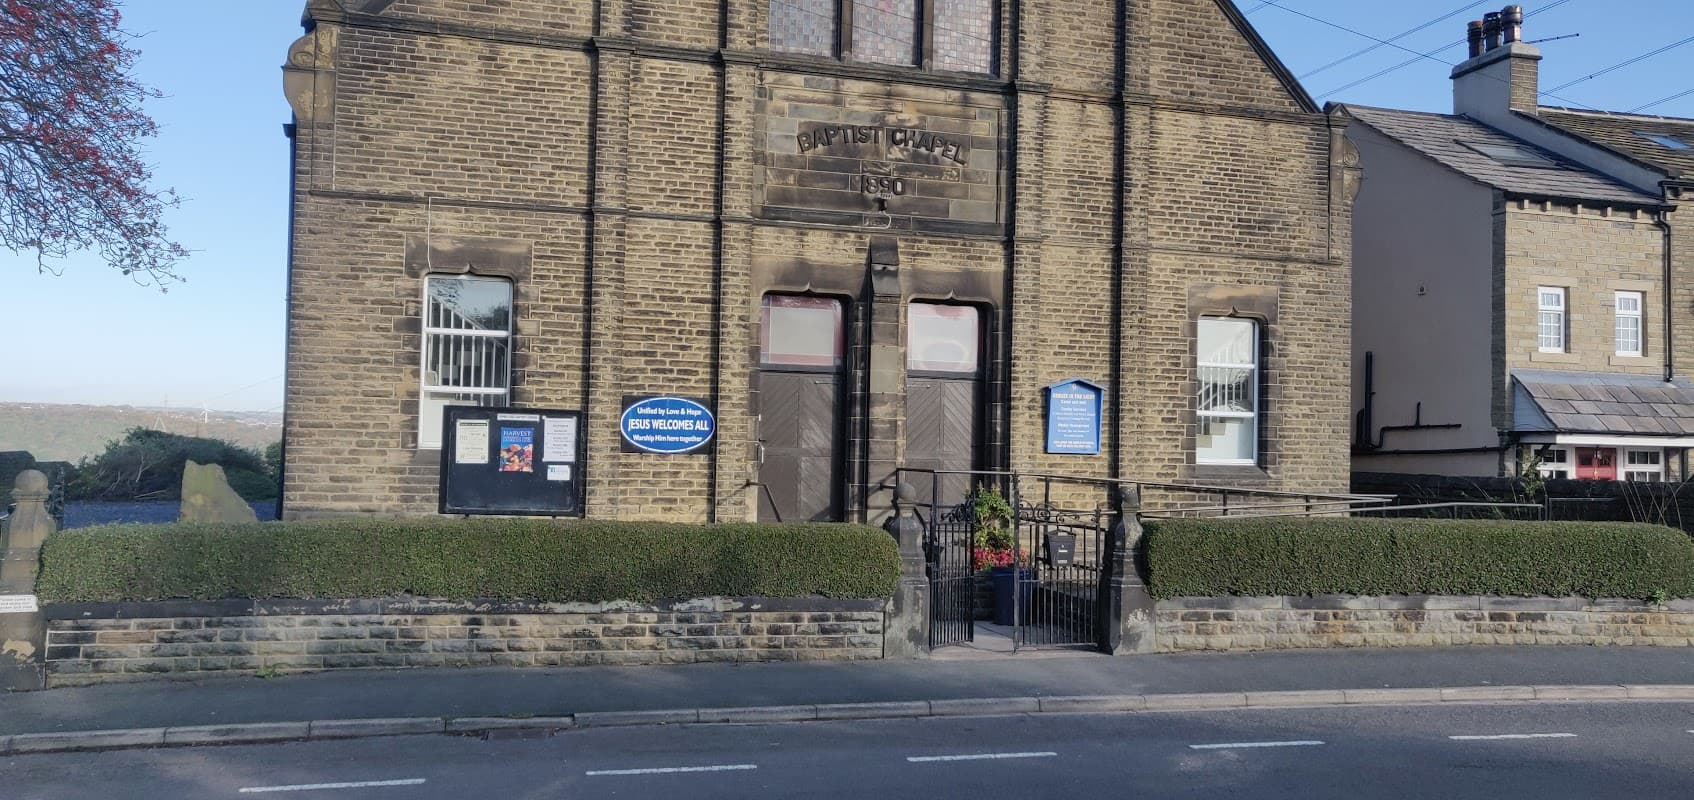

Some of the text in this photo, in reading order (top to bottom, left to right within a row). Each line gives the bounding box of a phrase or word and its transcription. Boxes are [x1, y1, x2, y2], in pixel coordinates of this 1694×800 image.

[797, 126, 967, 166] BAPTIST CHAPEL
[861, 175, 905, 195] 1890
[658, 408, 665, 416] by
[686, 408, 702, 417] Hope
[628, 418, 709, 432] JESUS WELCOMES ALL
[633, 434, 655, 443] Worship
[680, 435, 702, 444] together
